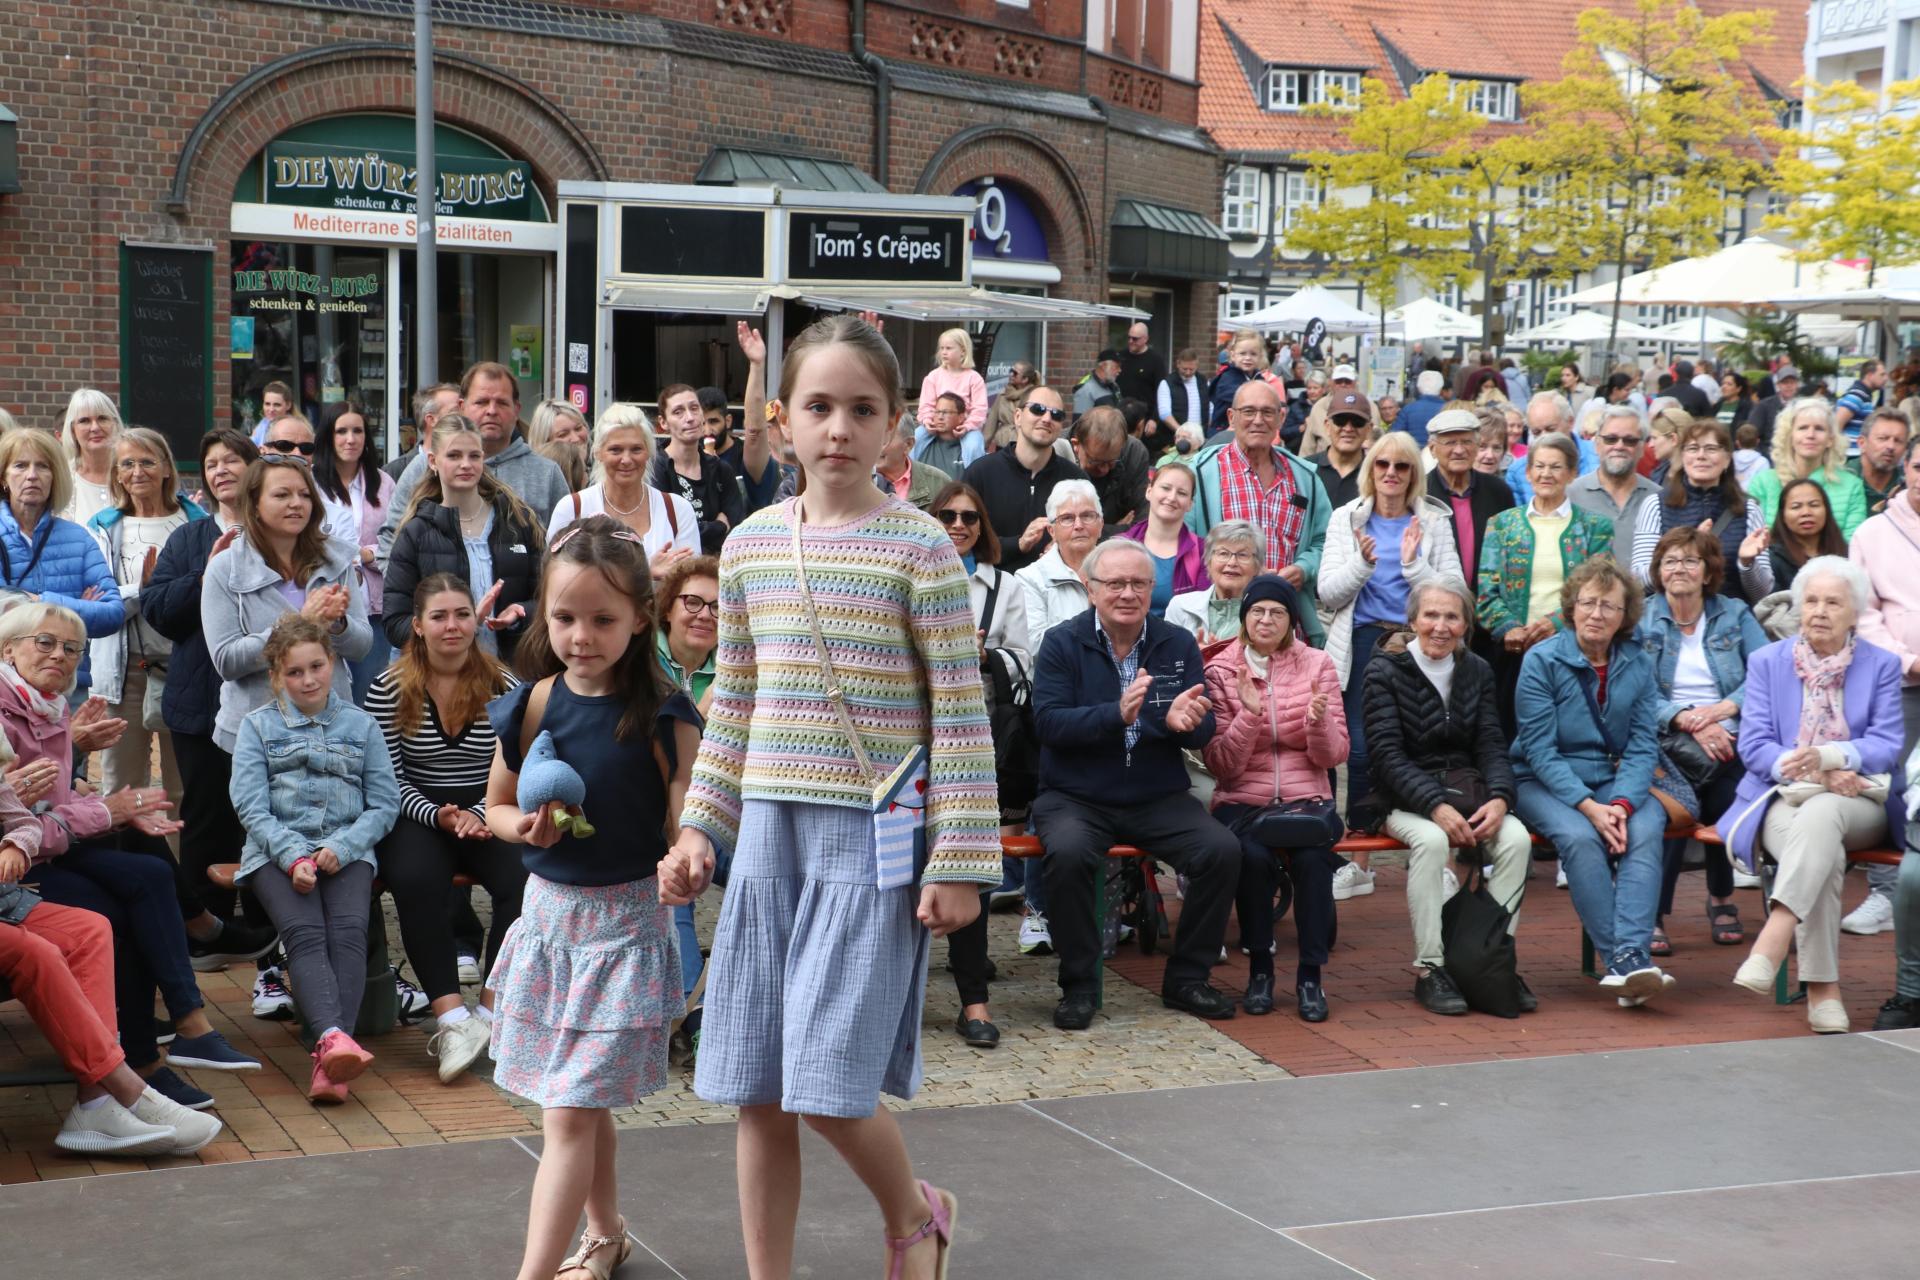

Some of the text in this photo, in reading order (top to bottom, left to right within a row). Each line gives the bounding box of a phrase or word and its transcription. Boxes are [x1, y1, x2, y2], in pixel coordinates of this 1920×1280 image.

[273, 156, 328, 188] DIE
[334, 195, 453, 214] schenken & geßen
[293, 212, 512, 243] Mediterrane Szialitäten
[877, 234, 941, 264] Crêpes
[234, 270, 266, 292] DIE
[249, 296, 368, 314] schenken & genießen
